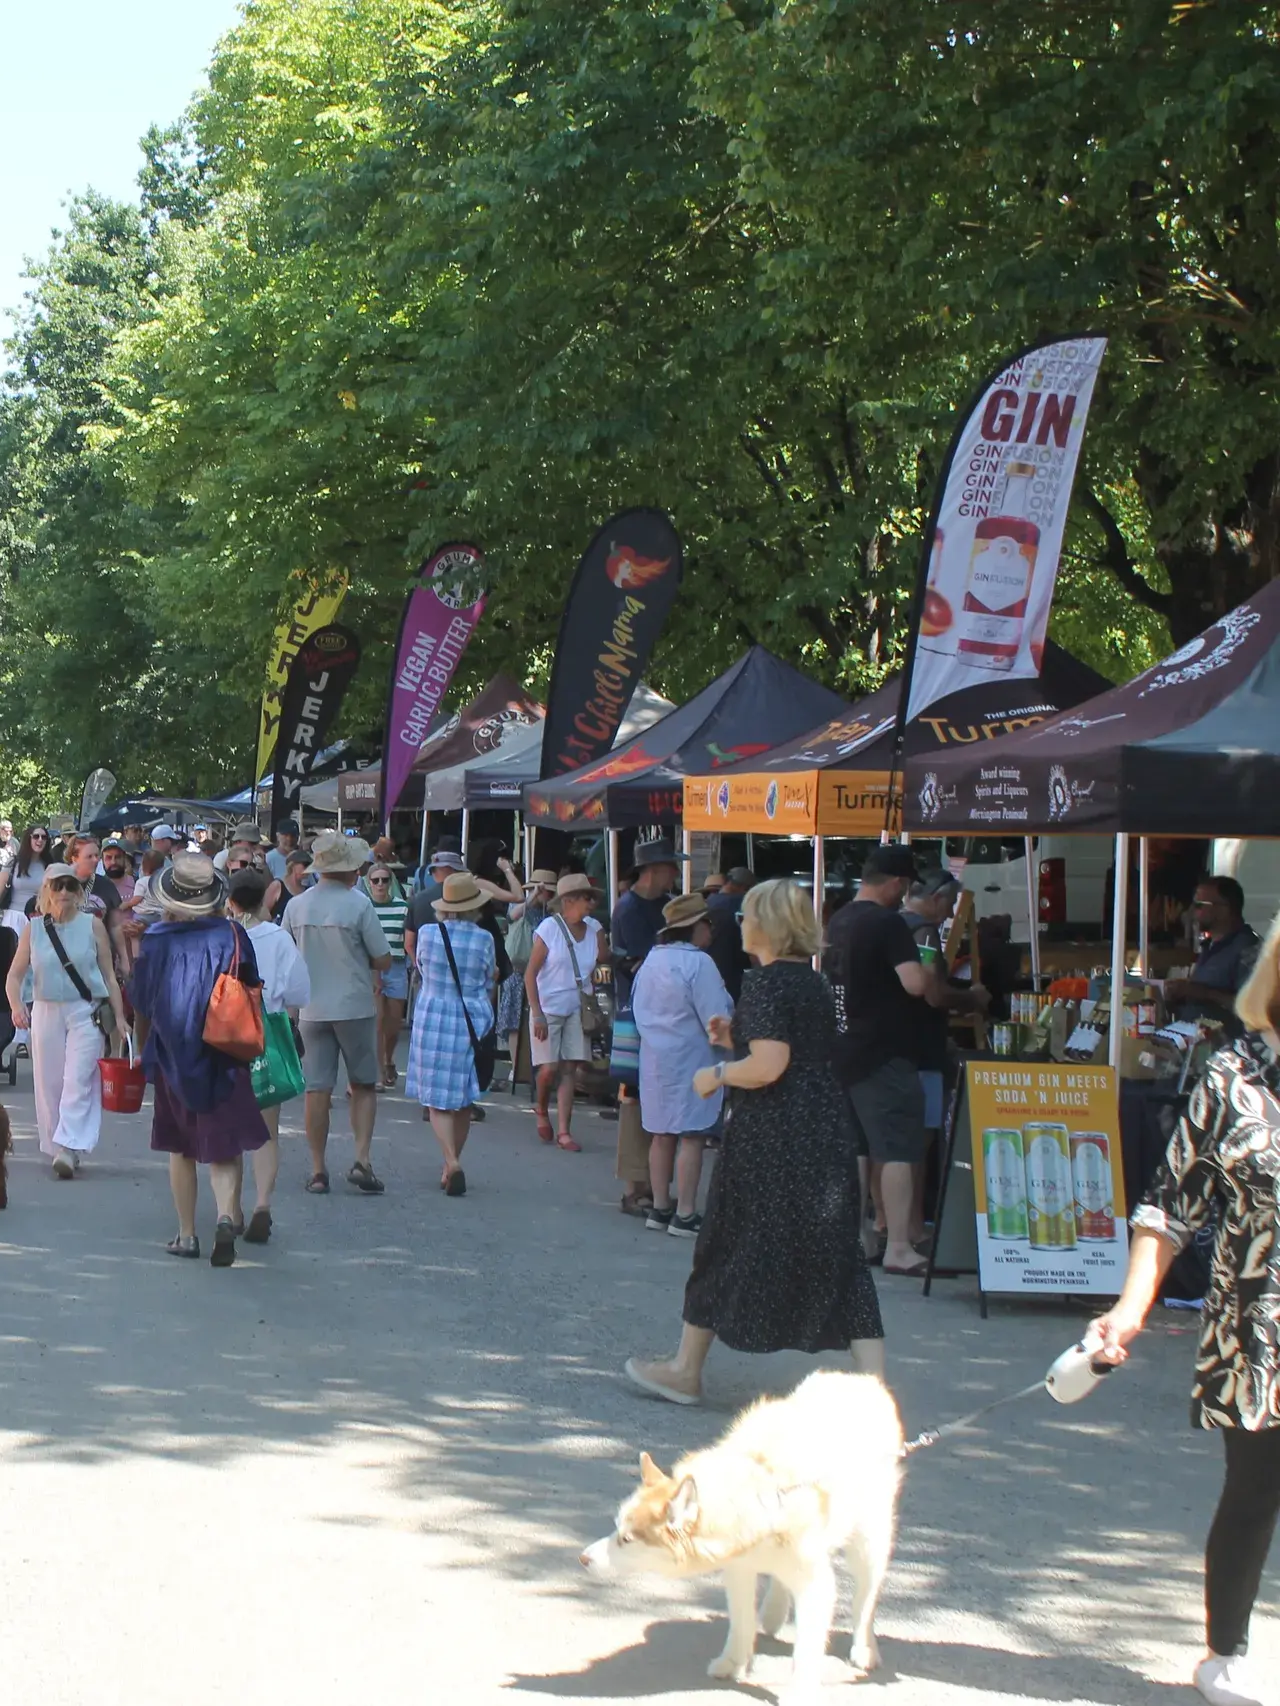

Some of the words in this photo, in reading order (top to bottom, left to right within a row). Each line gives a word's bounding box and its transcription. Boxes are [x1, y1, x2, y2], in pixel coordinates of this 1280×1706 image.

[980, 389, 1077, 448] GIN
[396, 631, 437, 693] VEGAN
[399, 682, 441, 747] GARLIC
[428, 616, 472, 684] BUTTER
[984, 712, 1007, 721] THE
[1008, 704, 1060, 717] ORIGINAL
[282, 671, 329, 799] JERKY
[980, 767, 998, 780] Award
[992, 784, 1003, 795] and
[974, 1071, 1032, 1086] PREMIUM
[1039, 1073, 1060, 1087] GIN
[1067, 1074, 1107, 1089] MEETS
[995, 1089, 1028, 1104] SODA
[1055, 1092, 1089, 1106] JUICE
